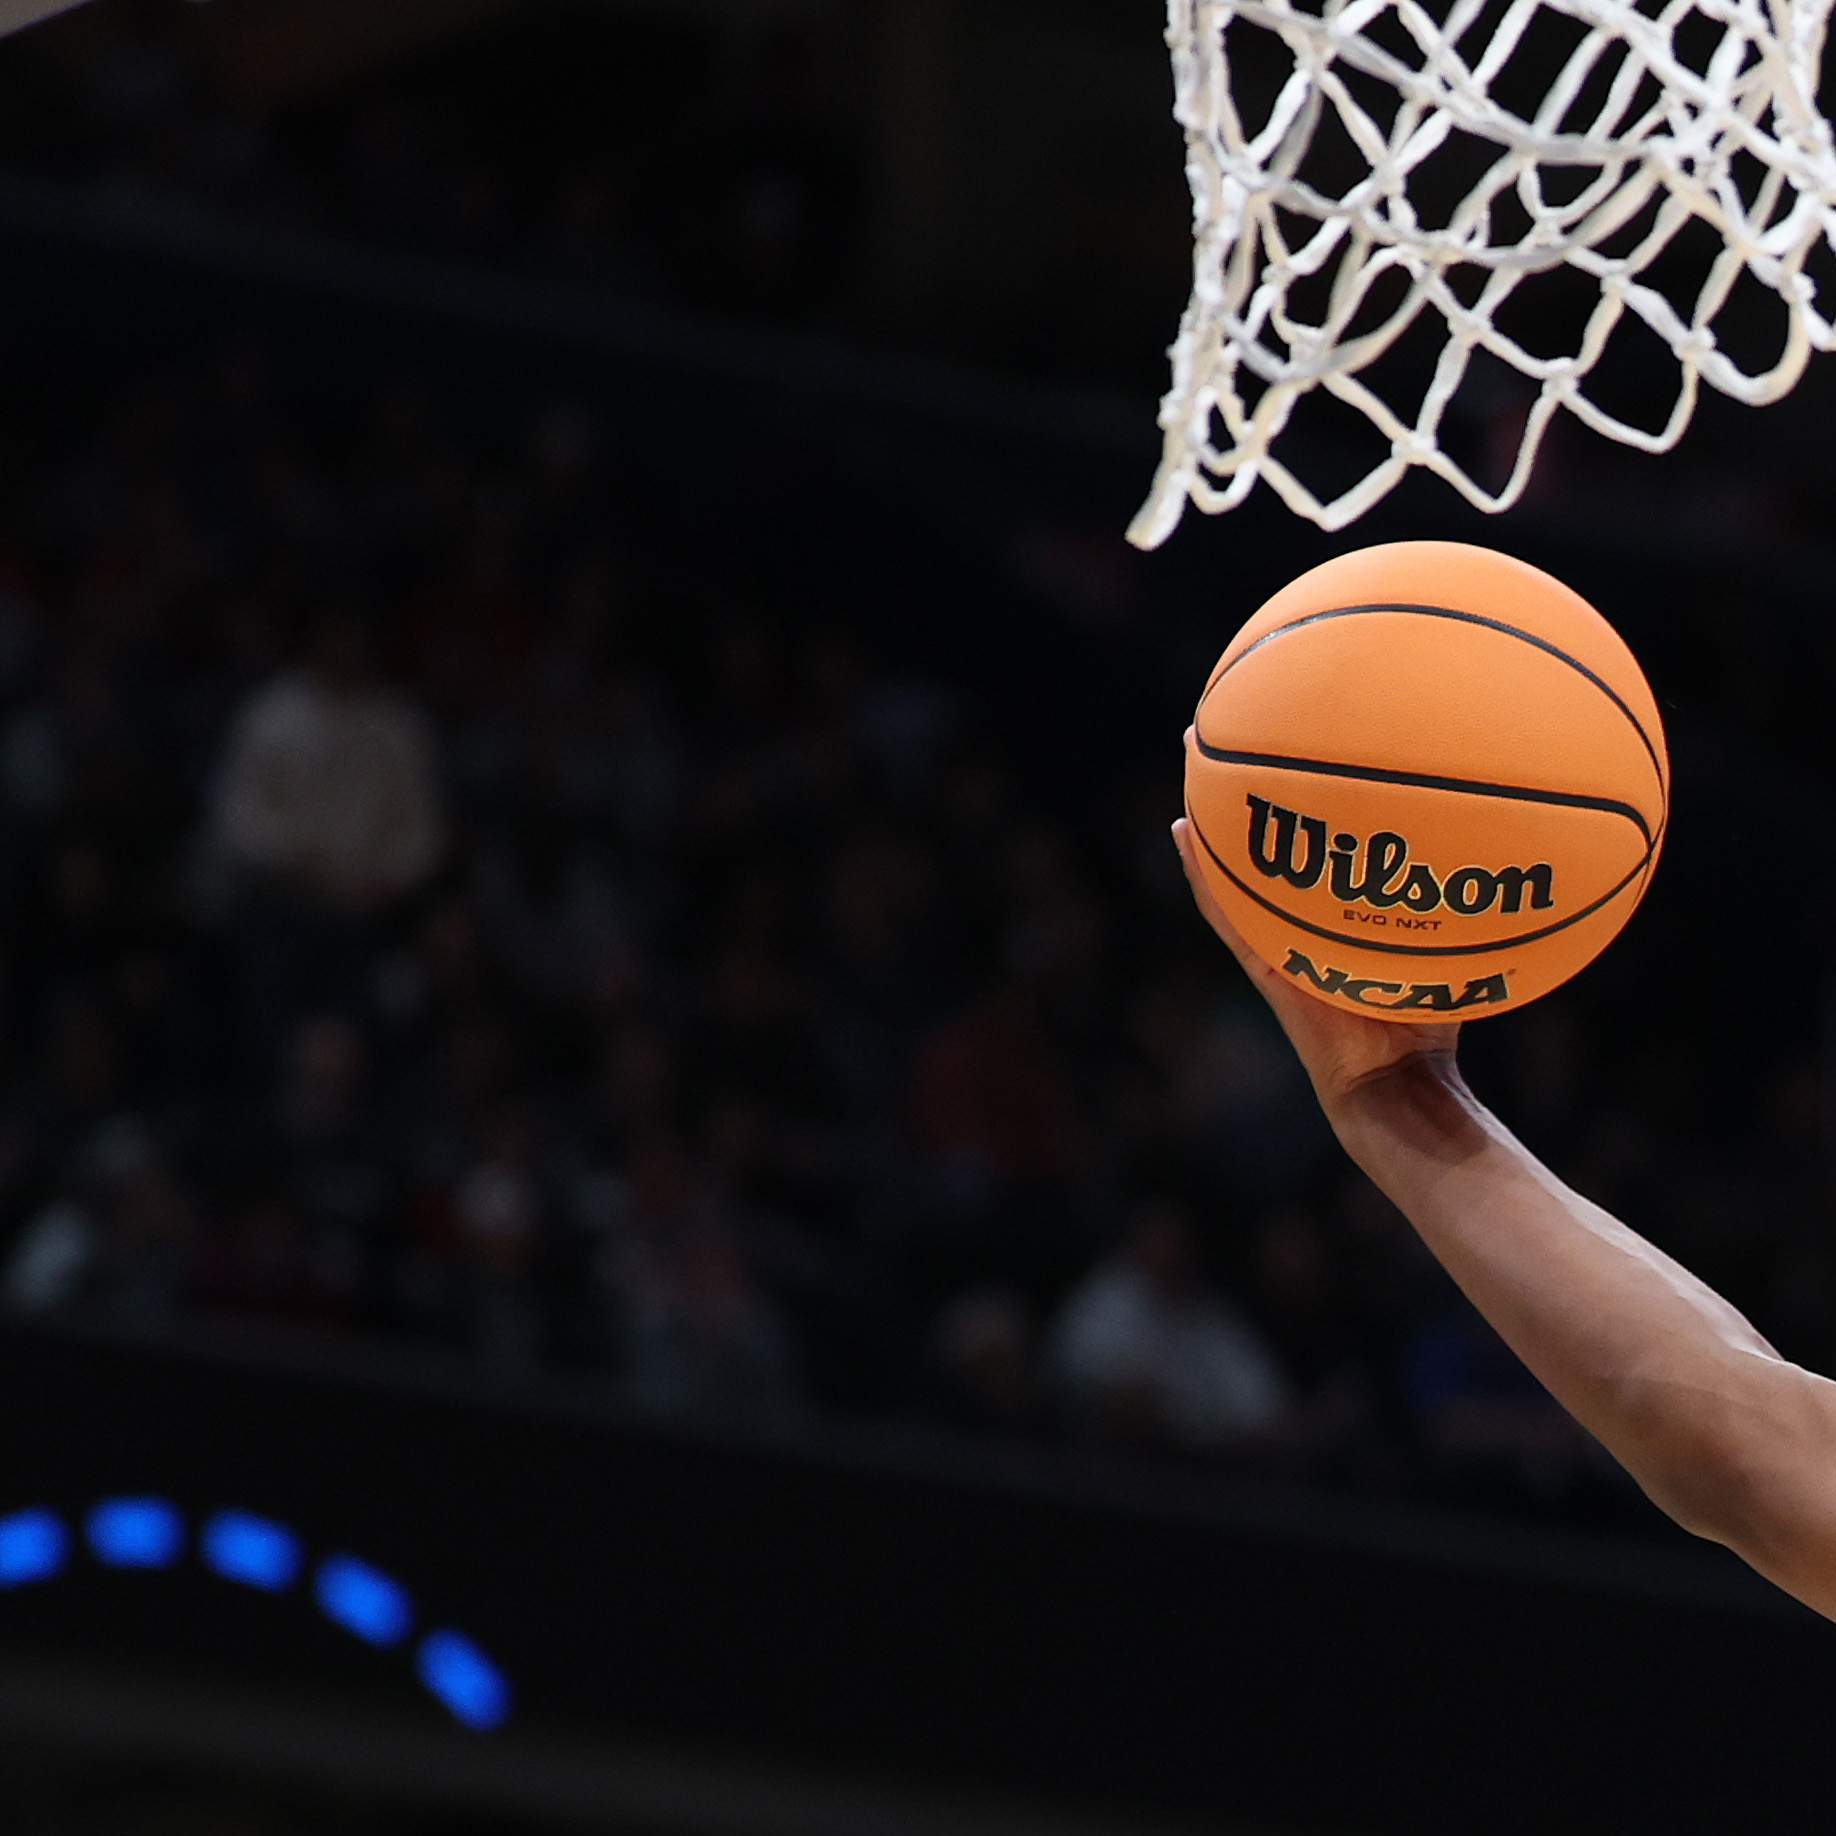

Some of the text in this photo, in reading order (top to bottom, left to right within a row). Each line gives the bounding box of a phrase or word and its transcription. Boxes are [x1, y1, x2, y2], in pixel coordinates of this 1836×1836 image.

[1246, 792, 1554, 916] Wilson
[1343, 909, 1442, 931] EVO NXT
[1281, 946, 1510, 1012] NCAA
